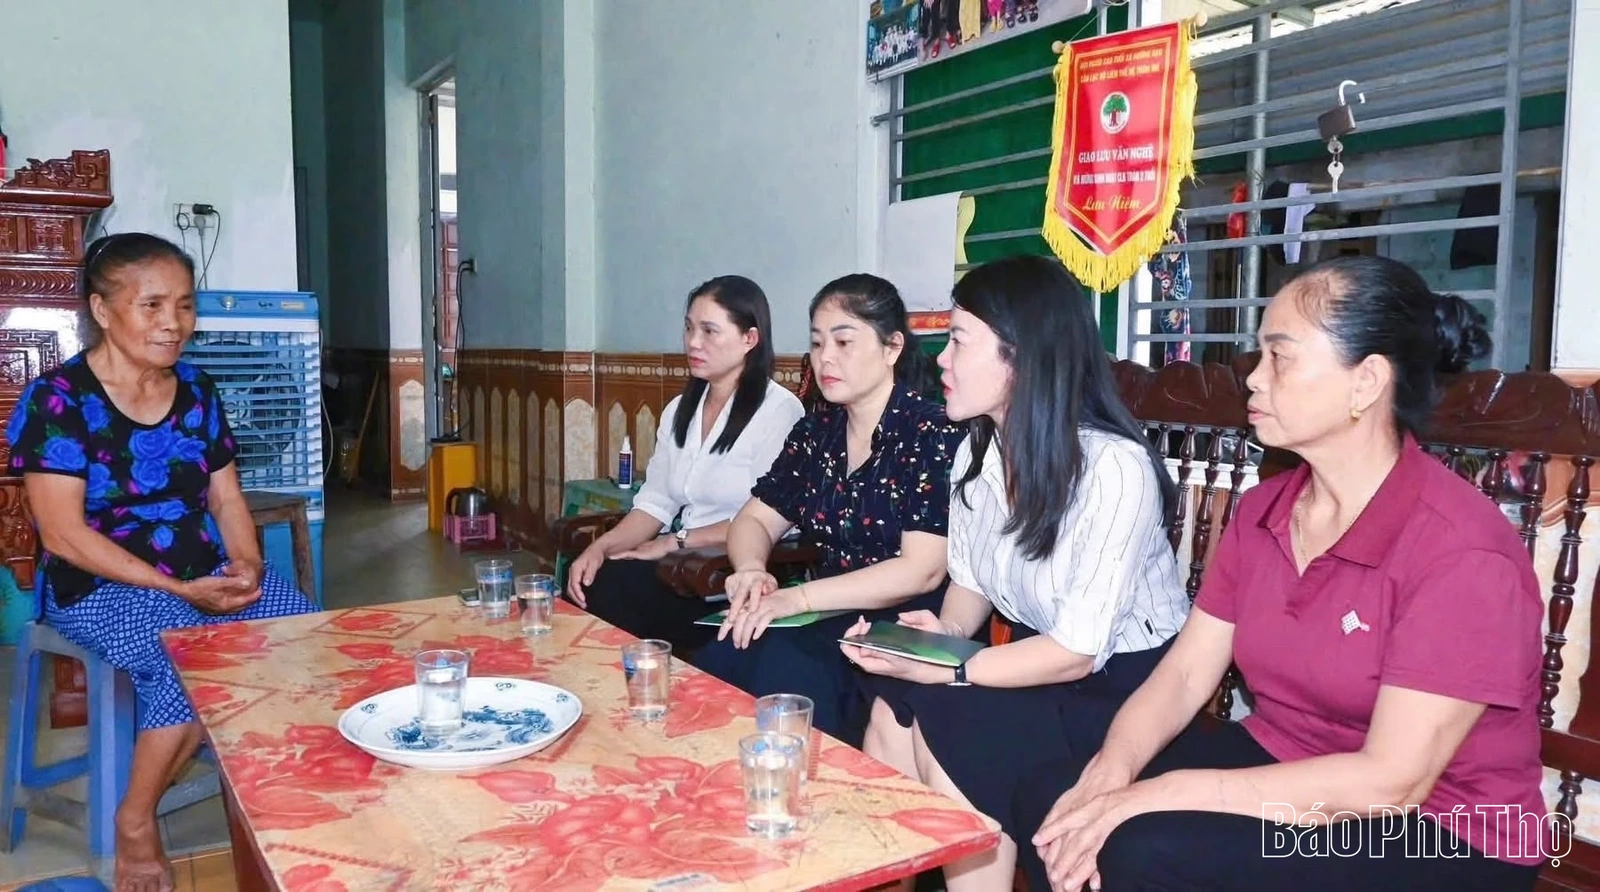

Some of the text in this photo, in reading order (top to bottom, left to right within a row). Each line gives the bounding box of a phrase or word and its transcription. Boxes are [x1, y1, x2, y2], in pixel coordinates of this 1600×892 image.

[1078, 151, 1095, 164] GIAO
[1096, 149, 1111, 162] LƯU
[1112, 145, 1128, 161] VĂN
[1082, 194, 1140, 212] Lưu Niệm
